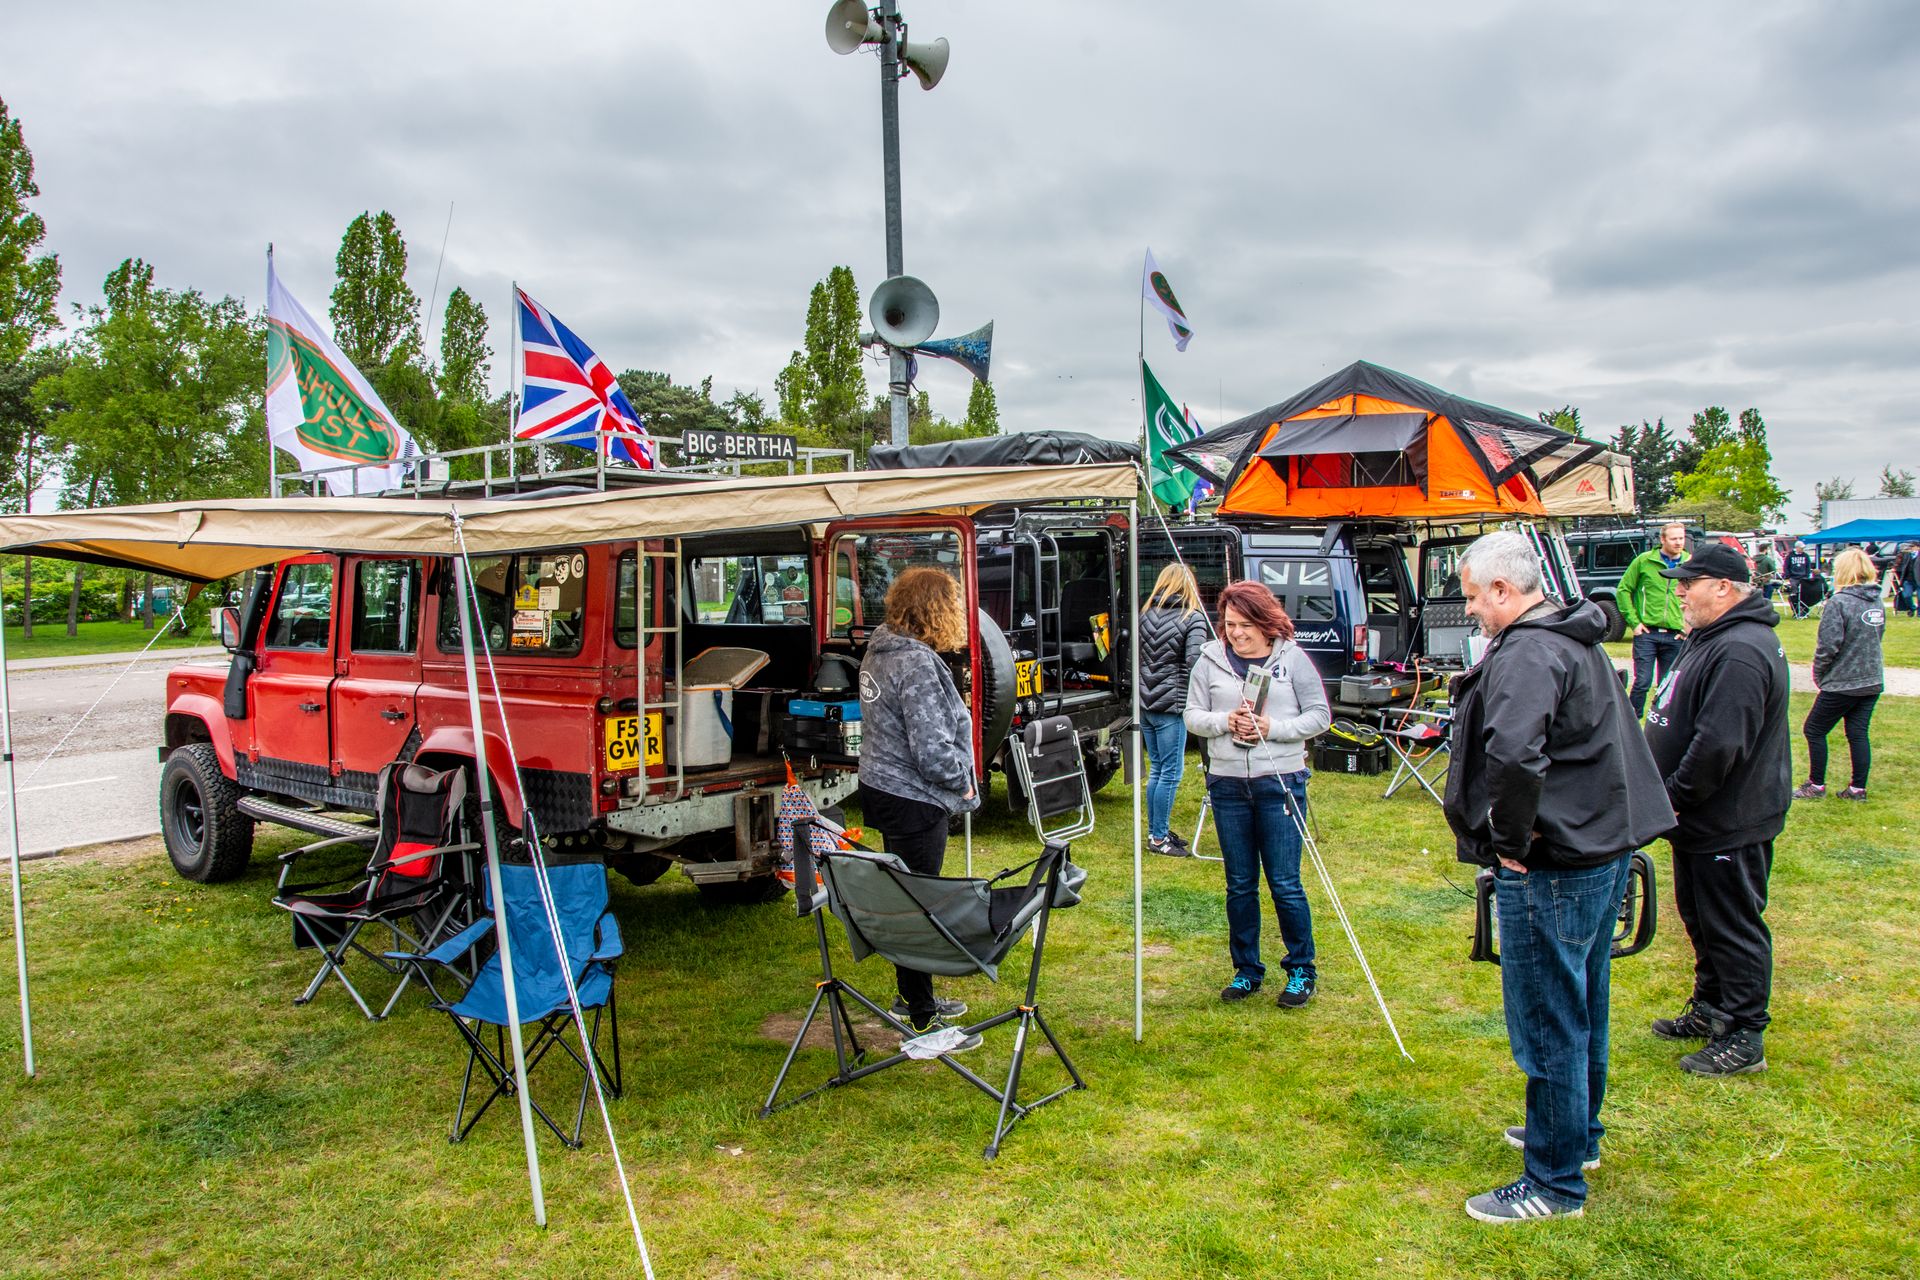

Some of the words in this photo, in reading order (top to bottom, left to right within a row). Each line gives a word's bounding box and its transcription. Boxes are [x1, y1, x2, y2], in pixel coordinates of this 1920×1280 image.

[290, 346, 365, 430] OLIHULL
[301, 395, 369, 448] UST
[688, 432, 717, 454] BIG
[725, 435, 794, 457] BERTHA
[1294, 631, 1320, 643] covery
[609, 737, 660, 760] GWR
